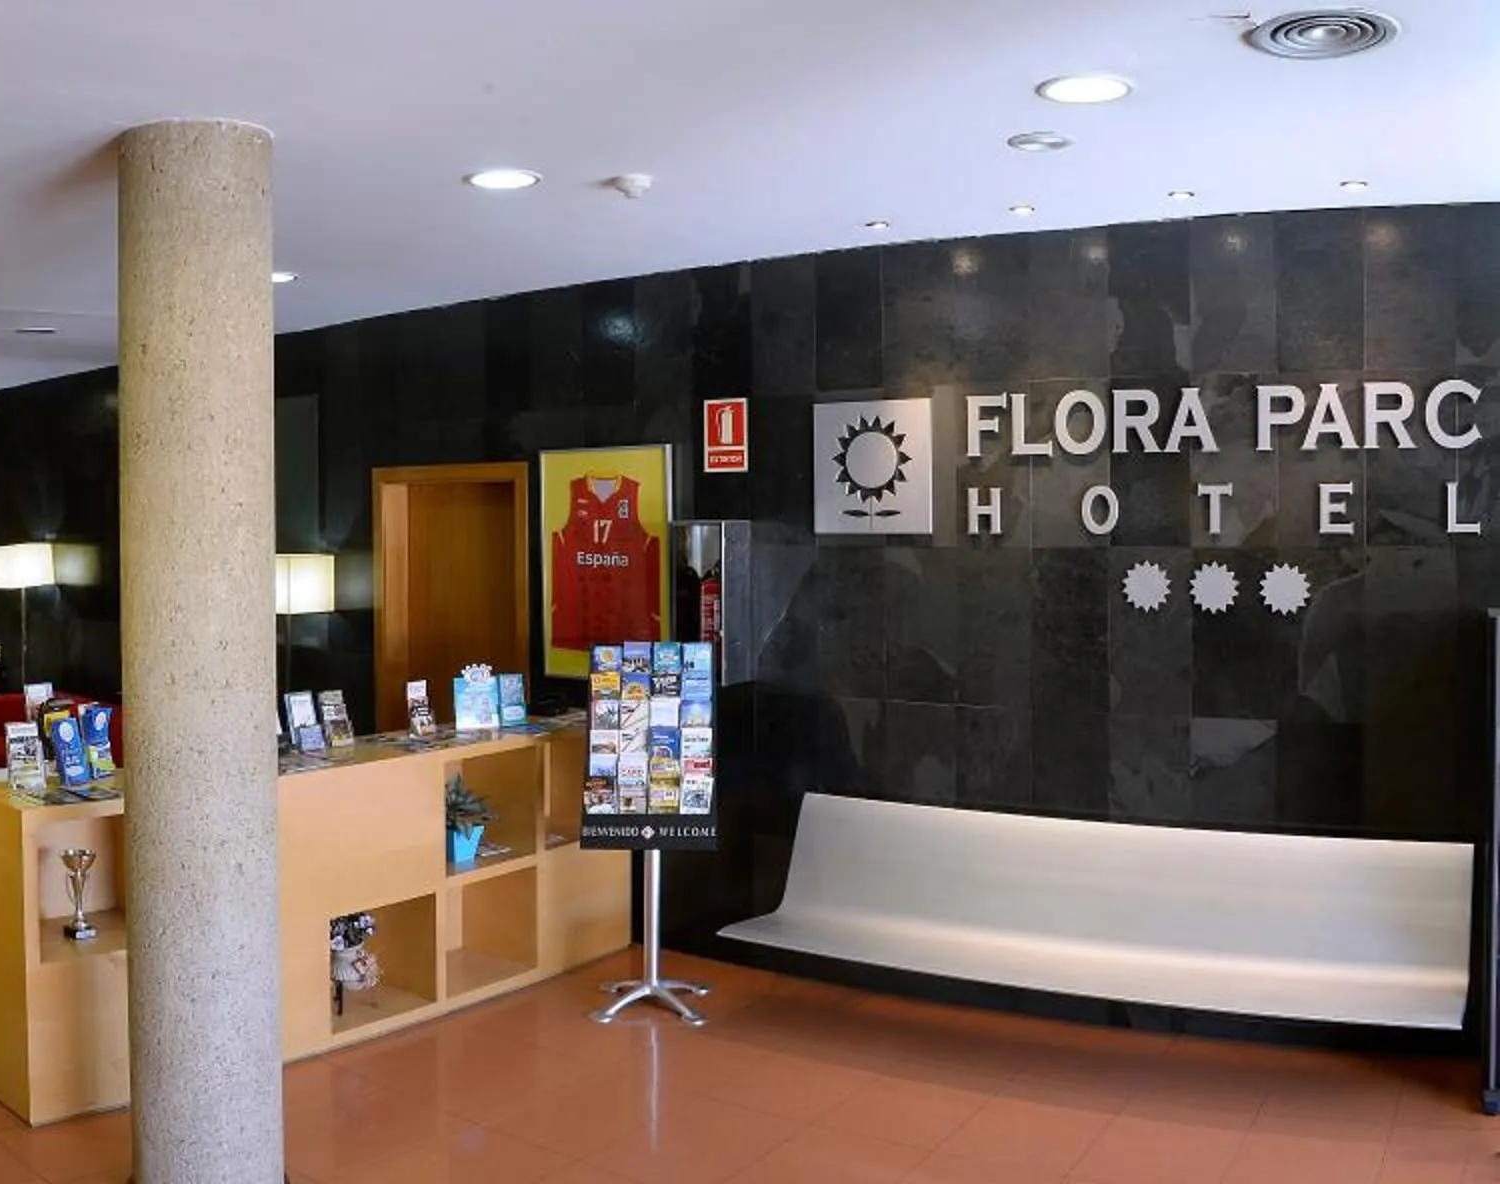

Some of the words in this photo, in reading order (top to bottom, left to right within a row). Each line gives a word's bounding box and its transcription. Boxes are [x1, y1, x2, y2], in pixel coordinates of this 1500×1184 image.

[965, 388, 1218, 457] FLORA
[1254, 379, 1483, 452] PARC
[593, 518, 613, 544] 17
[576, 551, 630, 569] España
[581, 825, 639, 838] BIENVENIDO
[659, 825, 717, 837] WELCOME
